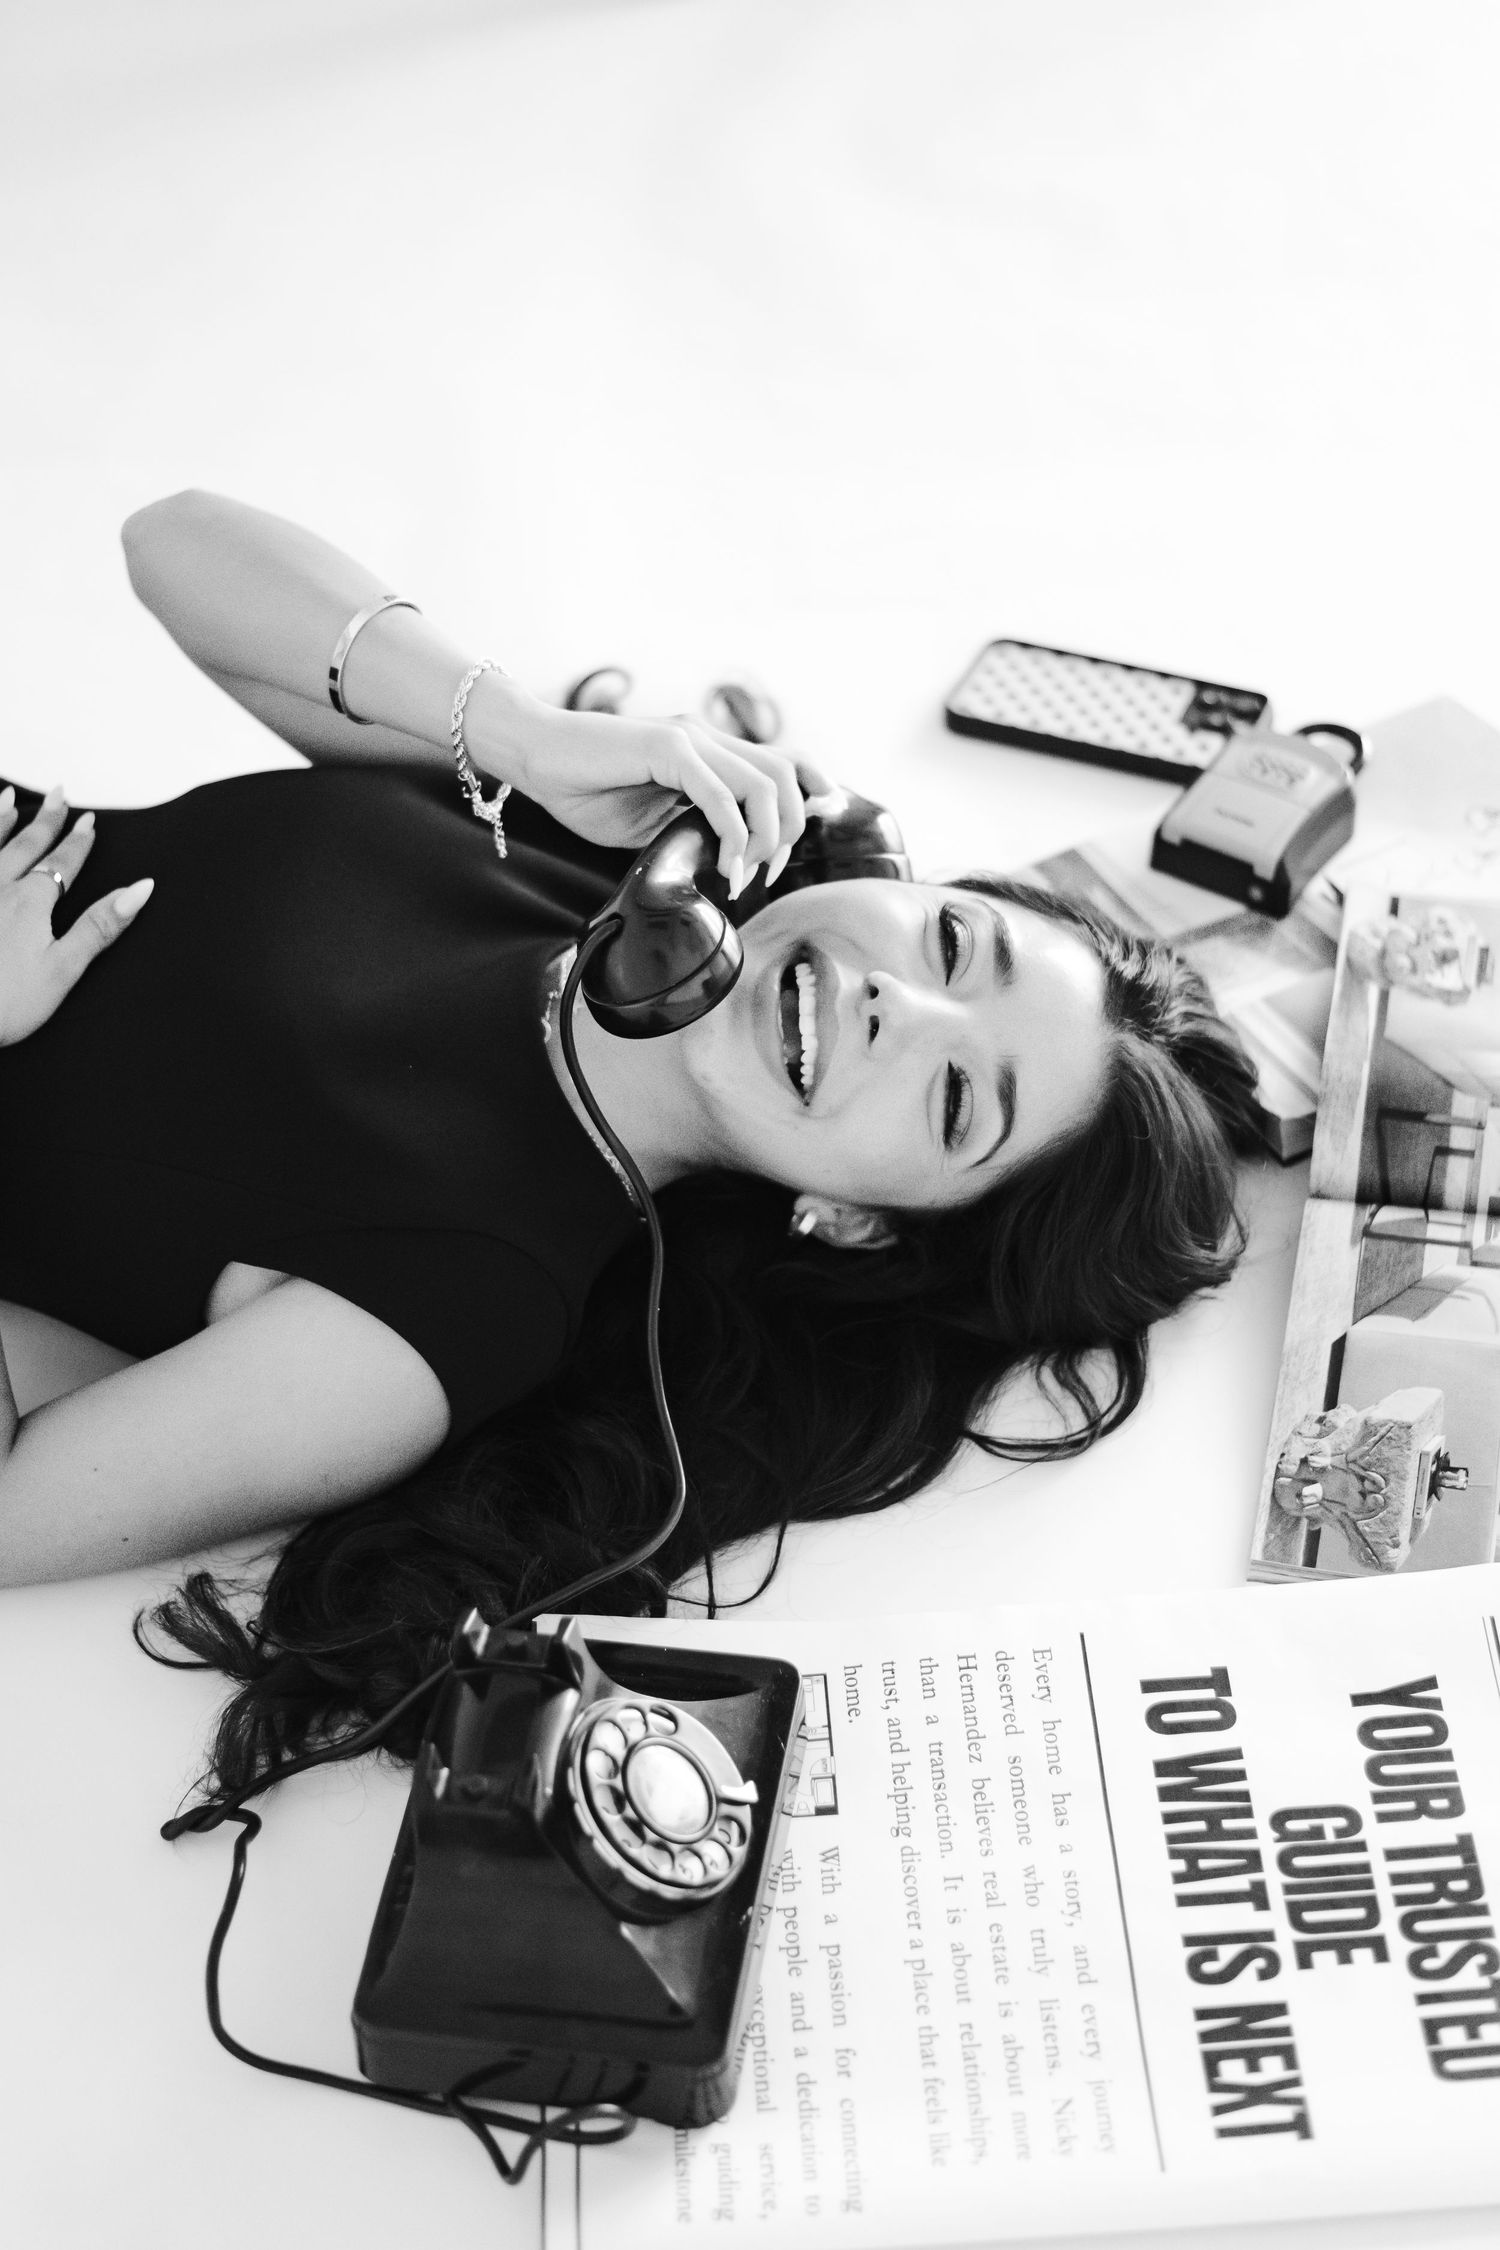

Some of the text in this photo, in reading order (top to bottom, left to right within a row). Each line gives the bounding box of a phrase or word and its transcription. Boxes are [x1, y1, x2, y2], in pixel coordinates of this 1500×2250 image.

[844, 1664, 862, 1723] home.
[920, 1657, 990, 2164] than a transaction. It is about relationships,
[957, 1653, 1032, 2160] Hernandez believes real estate is about more
[995, 1650, 1079, 2158] deserved someone who truly listens. Nicky
[1032, 1648, 1117, 2156] Every home has a story, and every journey
[1140, 1666, 1313, 2140] TO WHAT IS NEXT
[1270, 1805, 1390, 1970] GUIDE
[1350, 1675, 1500, 2081] YOUR TRUSTED
[776, 1848, 822, 2217] with people and a dedication to
[819, 1846, 865, 2214] With a passion for connecting
[881, 1661, 952, 2167] trust, and helping discover a place that feels like
[710, 2143, 741, 2223] guiding
